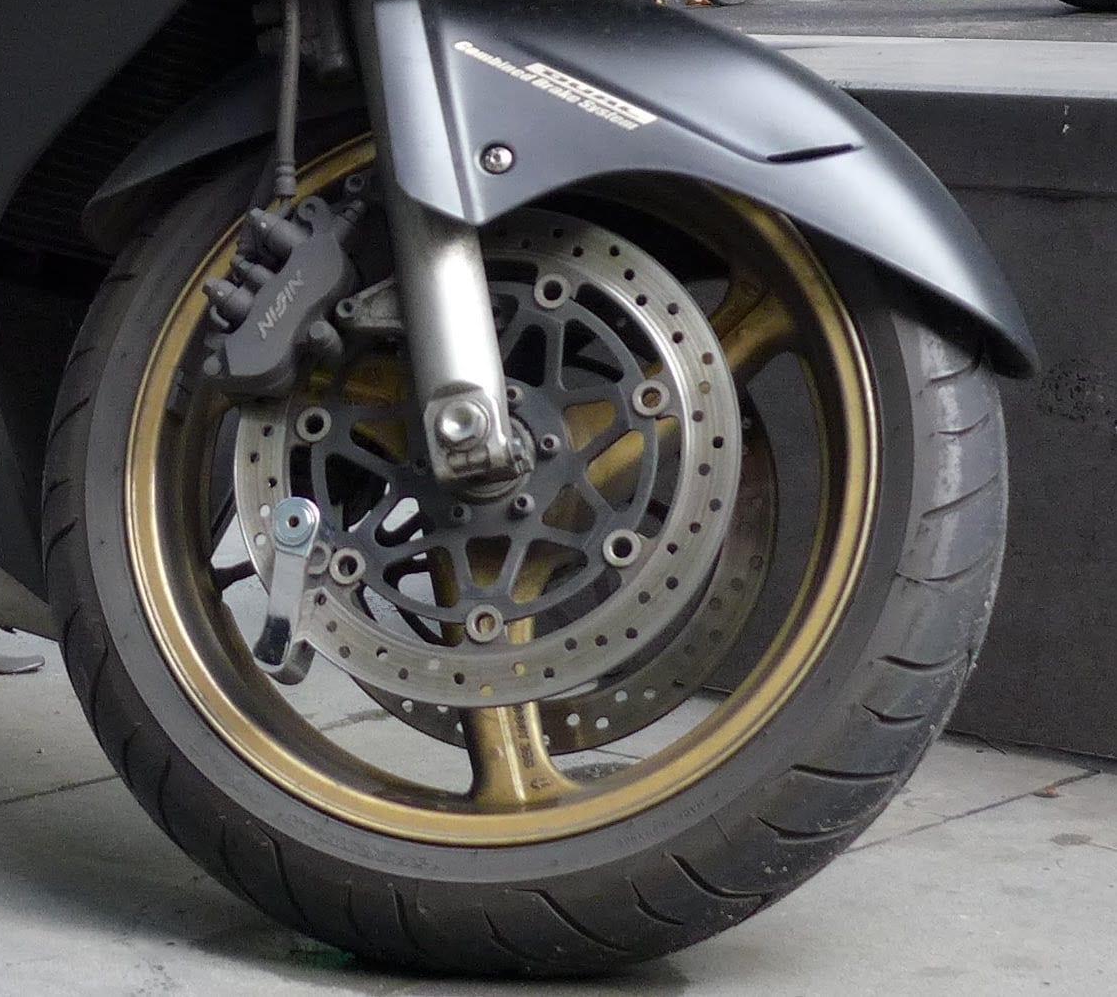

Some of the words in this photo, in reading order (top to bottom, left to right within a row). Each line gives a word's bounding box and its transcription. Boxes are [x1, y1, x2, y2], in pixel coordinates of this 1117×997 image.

[454, 40, 536, 82] Combined
[531, 77, 581, 104] Brake
[578, 98, 640, 131] System
